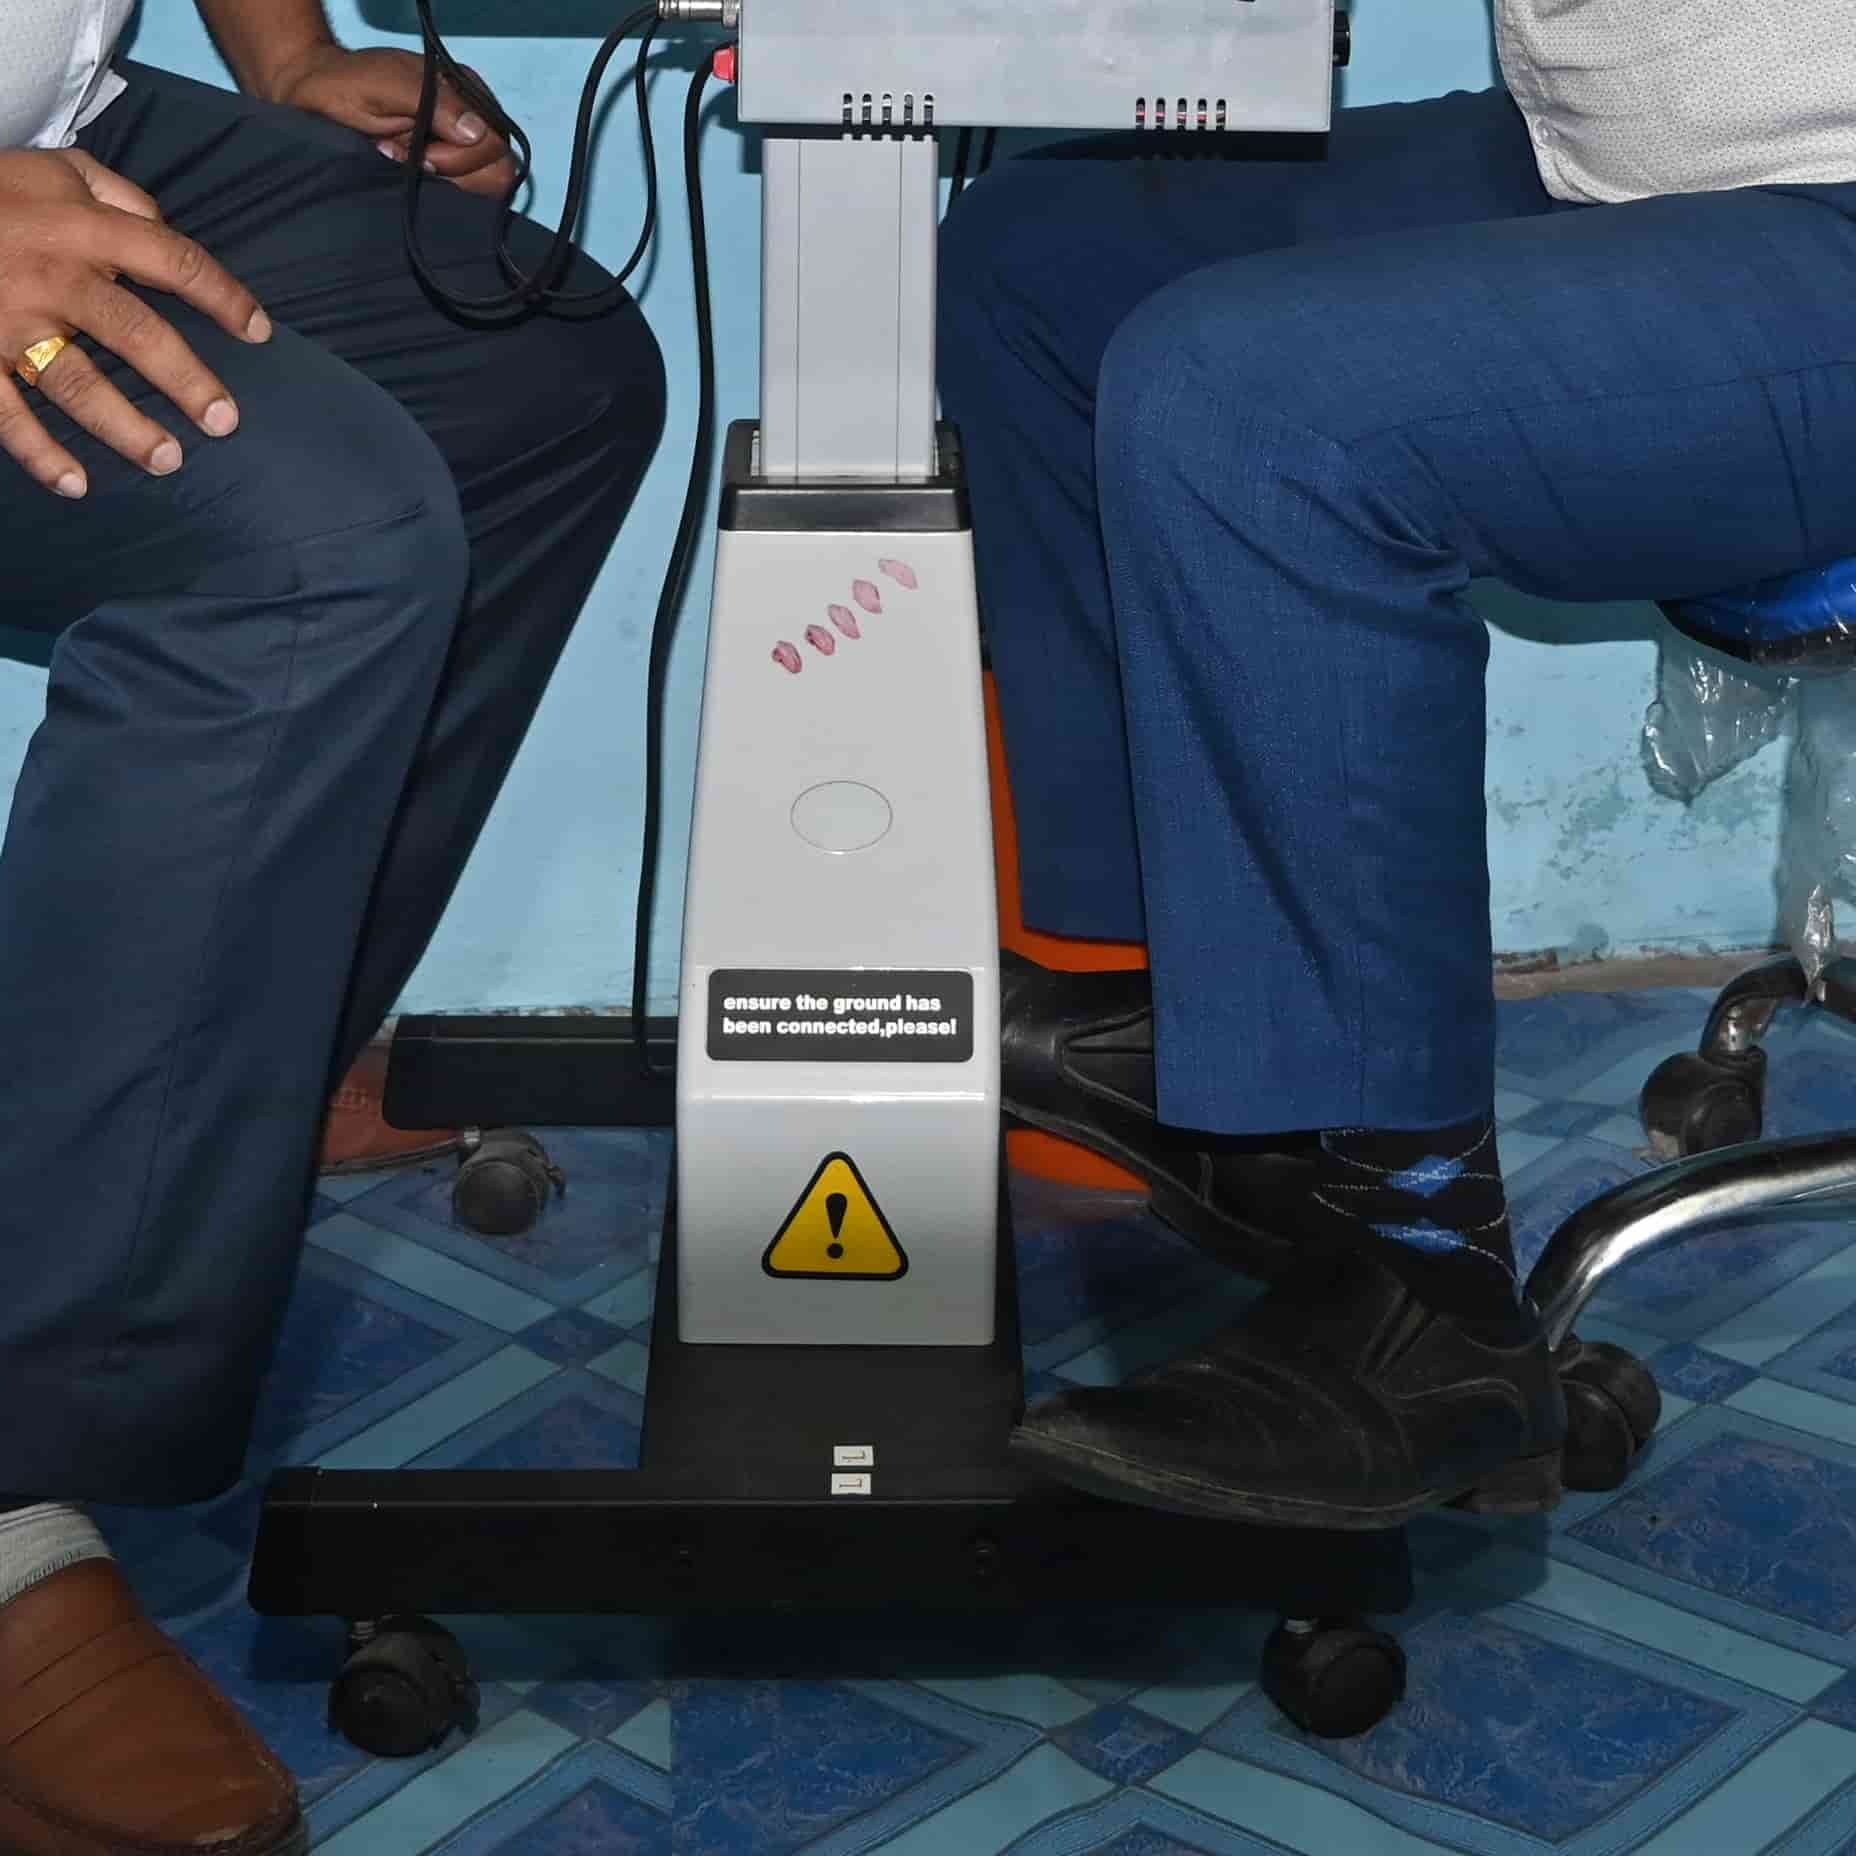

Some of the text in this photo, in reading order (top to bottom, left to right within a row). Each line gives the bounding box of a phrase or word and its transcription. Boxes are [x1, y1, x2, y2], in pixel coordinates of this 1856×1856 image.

[723, 994, 942, 1015] ensure the ground has
[722, 1017, 772, 1035] been
